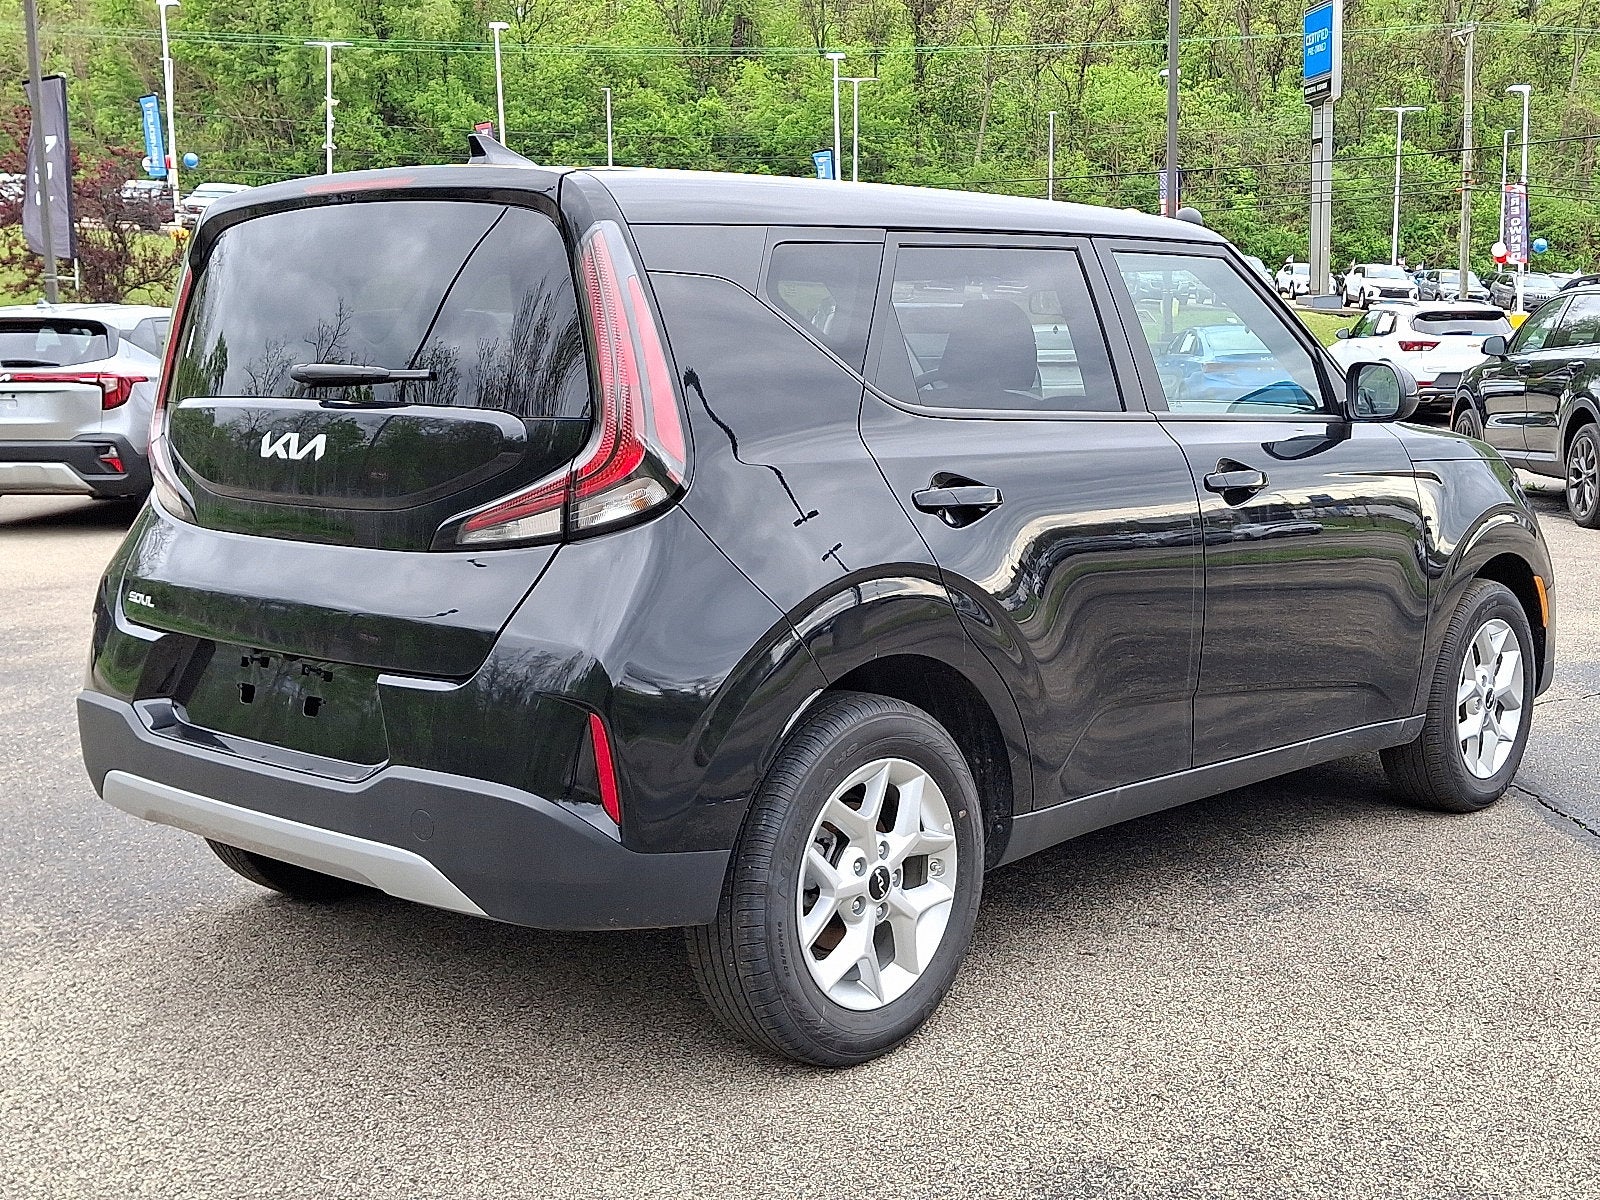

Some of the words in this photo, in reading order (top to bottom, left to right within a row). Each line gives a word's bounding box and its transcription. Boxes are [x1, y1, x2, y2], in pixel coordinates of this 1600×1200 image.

[1305, 27, 1329, 46] CERTIFIED
[260, 430, 327, 462] KIA
[128, 590, 155, 608] SOUL
